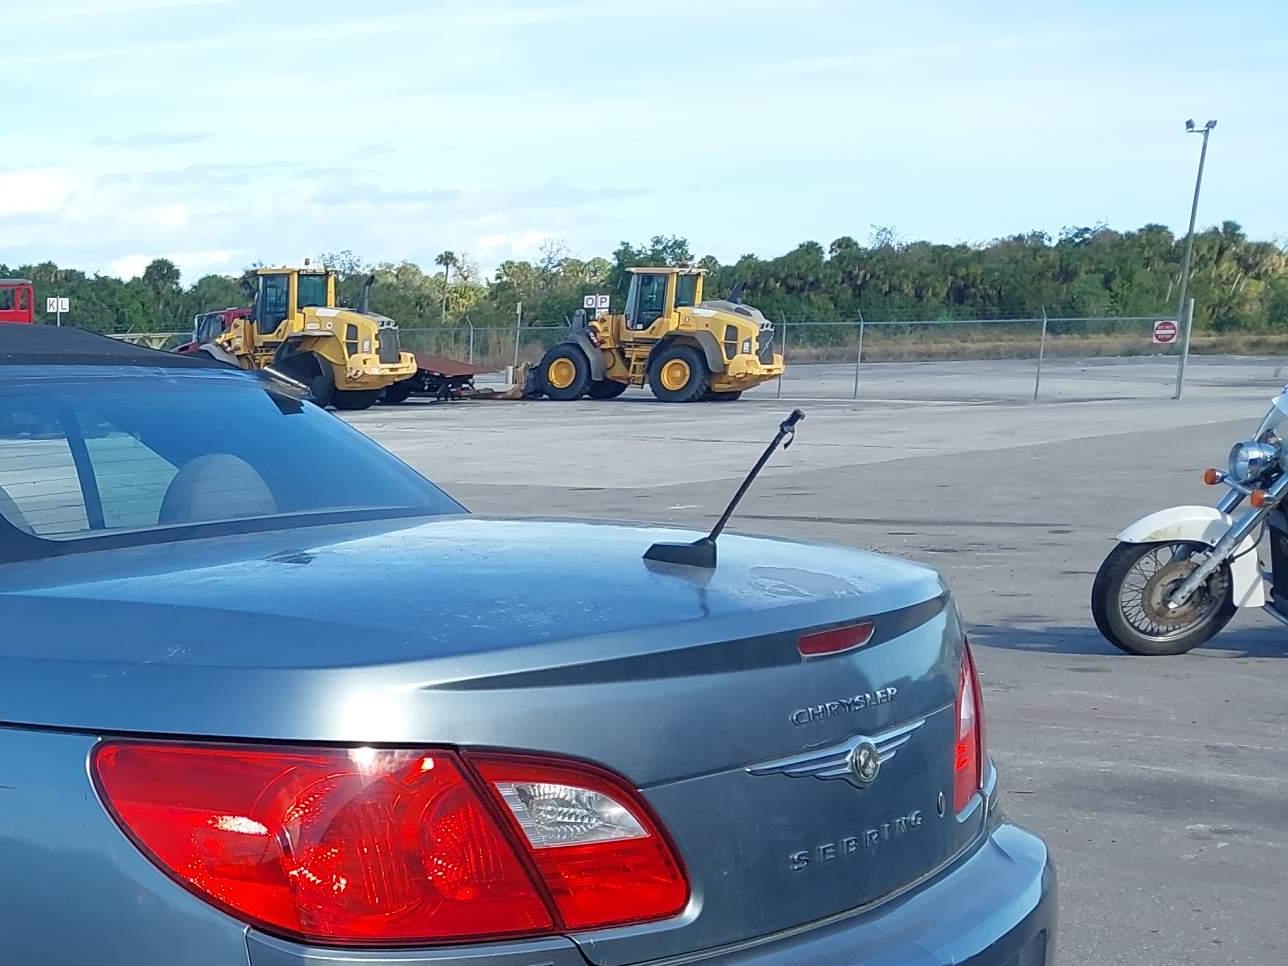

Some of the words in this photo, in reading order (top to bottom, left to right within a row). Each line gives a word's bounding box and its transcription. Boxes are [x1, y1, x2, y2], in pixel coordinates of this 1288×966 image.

[48, 299, 56, 310] K
[60, 299, 68, 310] L
[600, 296, 608, 306] P
[790, 687, 897, 727] CHRYSLER
[789, 810, 923, 871] SEBRING
